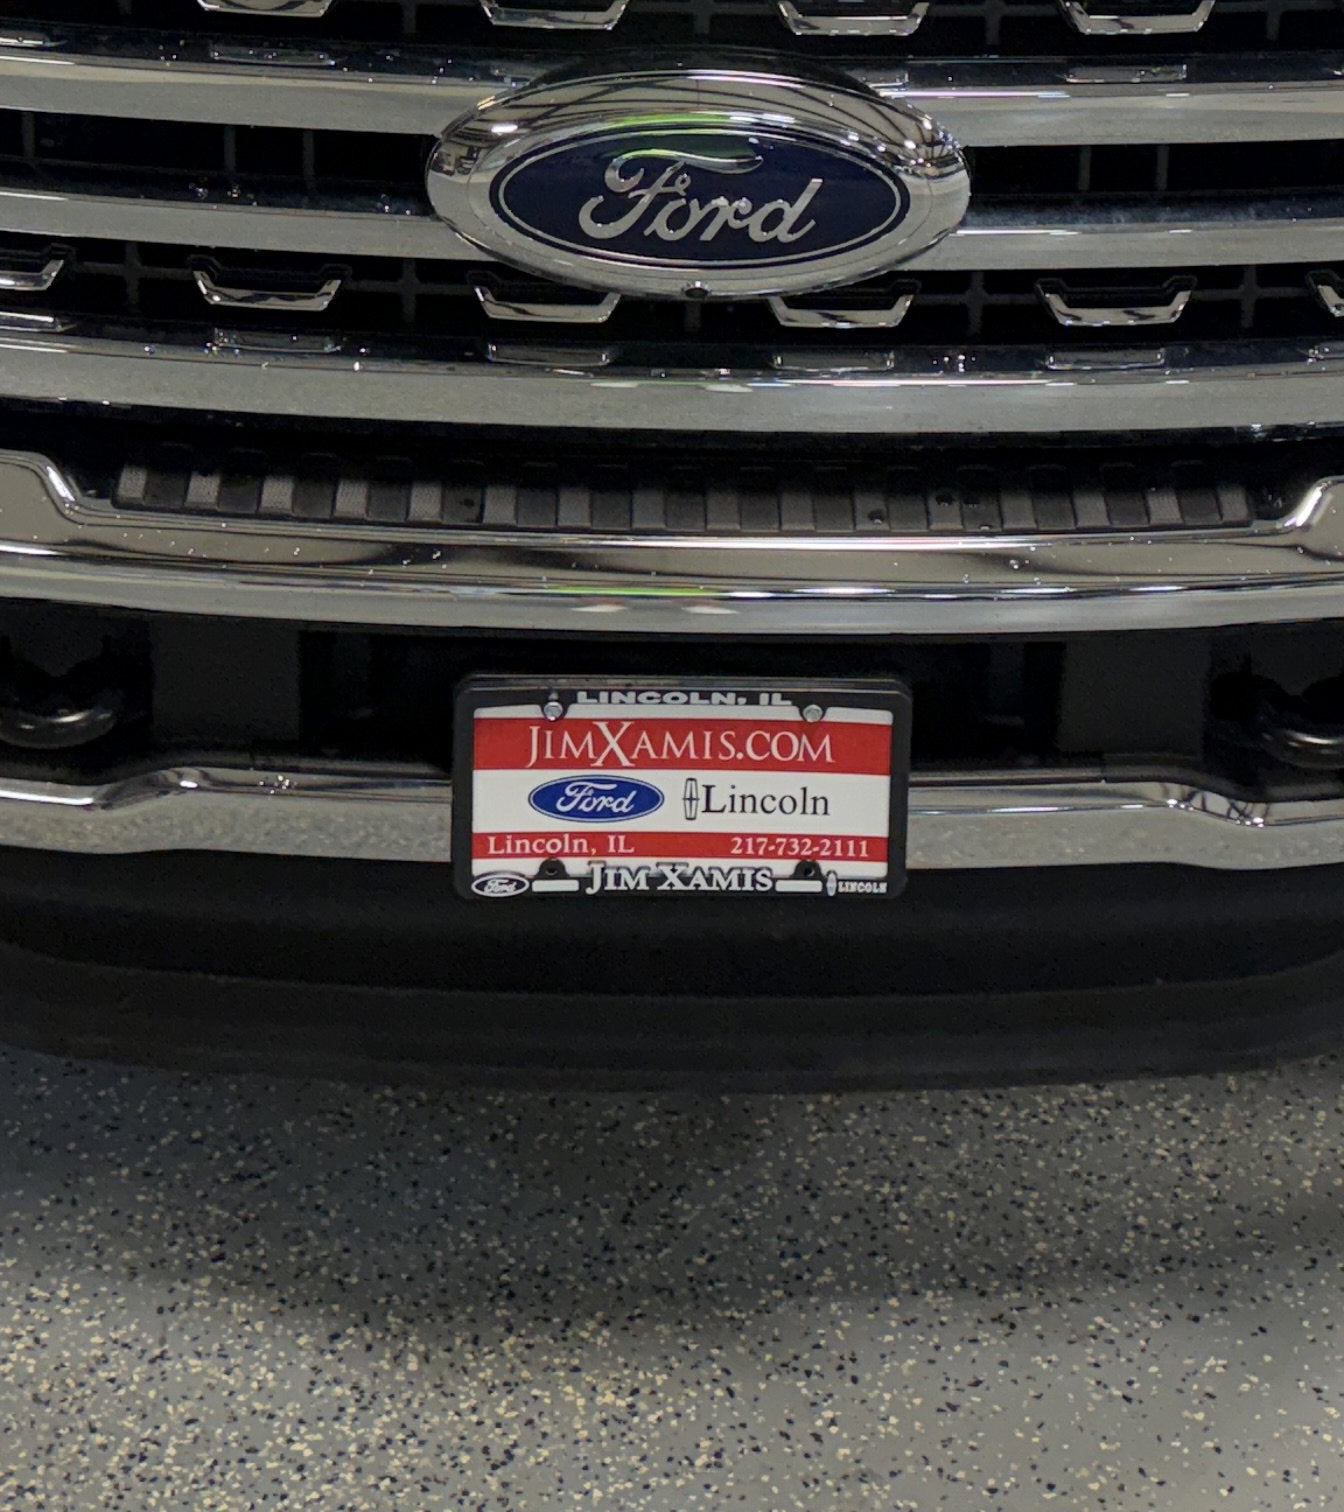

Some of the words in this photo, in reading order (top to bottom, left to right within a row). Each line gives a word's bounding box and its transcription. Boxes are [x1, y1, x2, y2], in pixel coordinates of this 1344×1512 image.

[578, 147, 824, 244] Ford
[759, 692, 793, 706] IL
[555, 782, 638, 814] Ford
[701, 784, 831, 816] Lincoln
[487, 834, 597, 855] Lincoln,
[608, 834, 635, 854] IL
[730, 836, 869, 857] 217-732-2111
